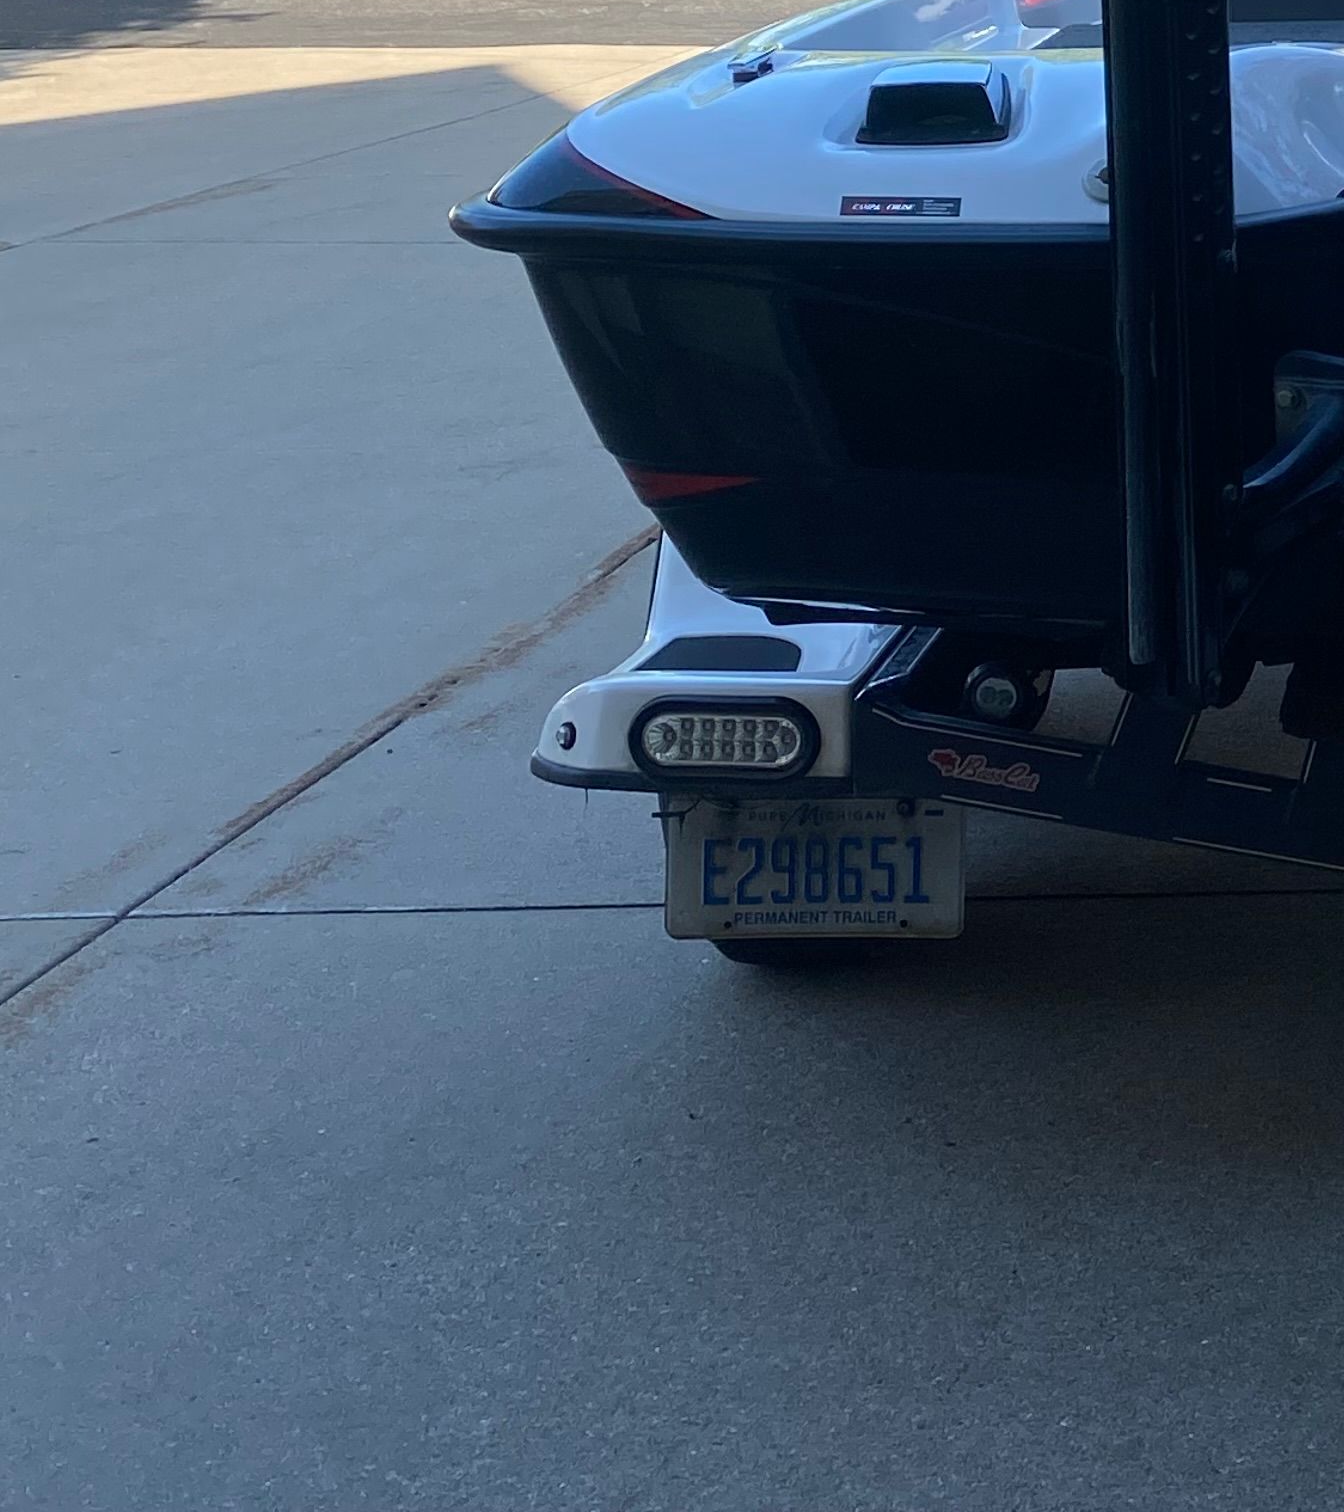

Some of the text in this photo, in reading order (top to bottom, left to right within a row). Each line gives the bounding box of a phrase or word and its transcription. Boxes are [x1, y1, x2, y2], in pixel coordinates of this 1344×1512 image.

[749, 811, 786, 823] PURE
[703, 836, 930, 906] E298651
[733, 910, 897, 925] PERMANENT TRAILER
